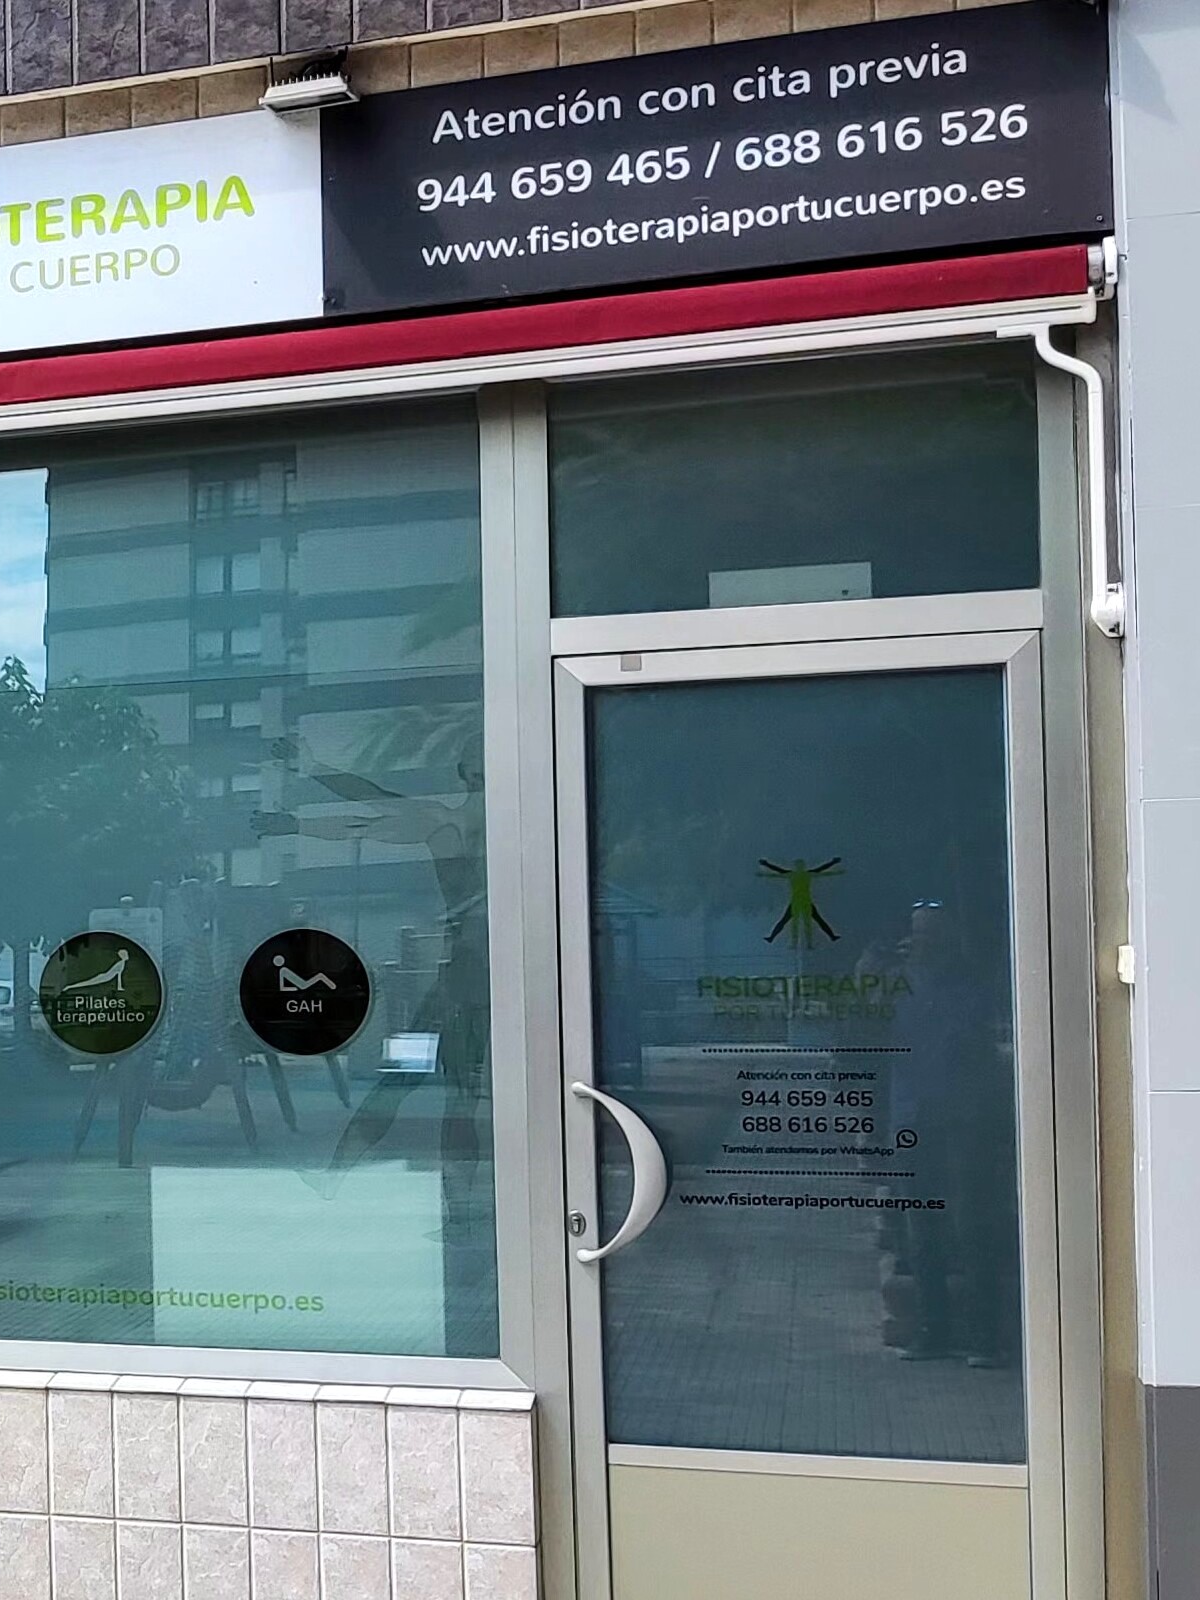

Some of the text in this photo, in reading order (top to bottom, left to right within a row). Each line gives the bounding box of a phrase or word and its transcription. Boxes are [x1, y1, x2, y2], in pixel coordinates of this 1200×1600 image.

[432, 42, 967, 144] Atención con cita previa
[417, 103, 1028, 212] 944 659 465 / 688 616 526
[417, 168, 1026, 266] www.fisioterapiaportucuerpo.es
[9, 243, 181, 293] CUERPO
[698, 974, 914, 999] FISIOTERAPIA
[75, 996, 126, 1011] Pilates
[286, 999, 323, 1013] GAH
[737, 1069, 788, 1081] Atención
[791, 1071, 812, 1081] con
[815, 1070, 836, 1081] cita
[741, 1090, 874, 1107] 944 659 465
[742, 1116, 874, 1134] 688 616 526
[722, 1144, 895, 1158] También atendemos por WhatsApp
[679, 1191, 946, 1212] www.fisioterapiaportucuerpo.es
